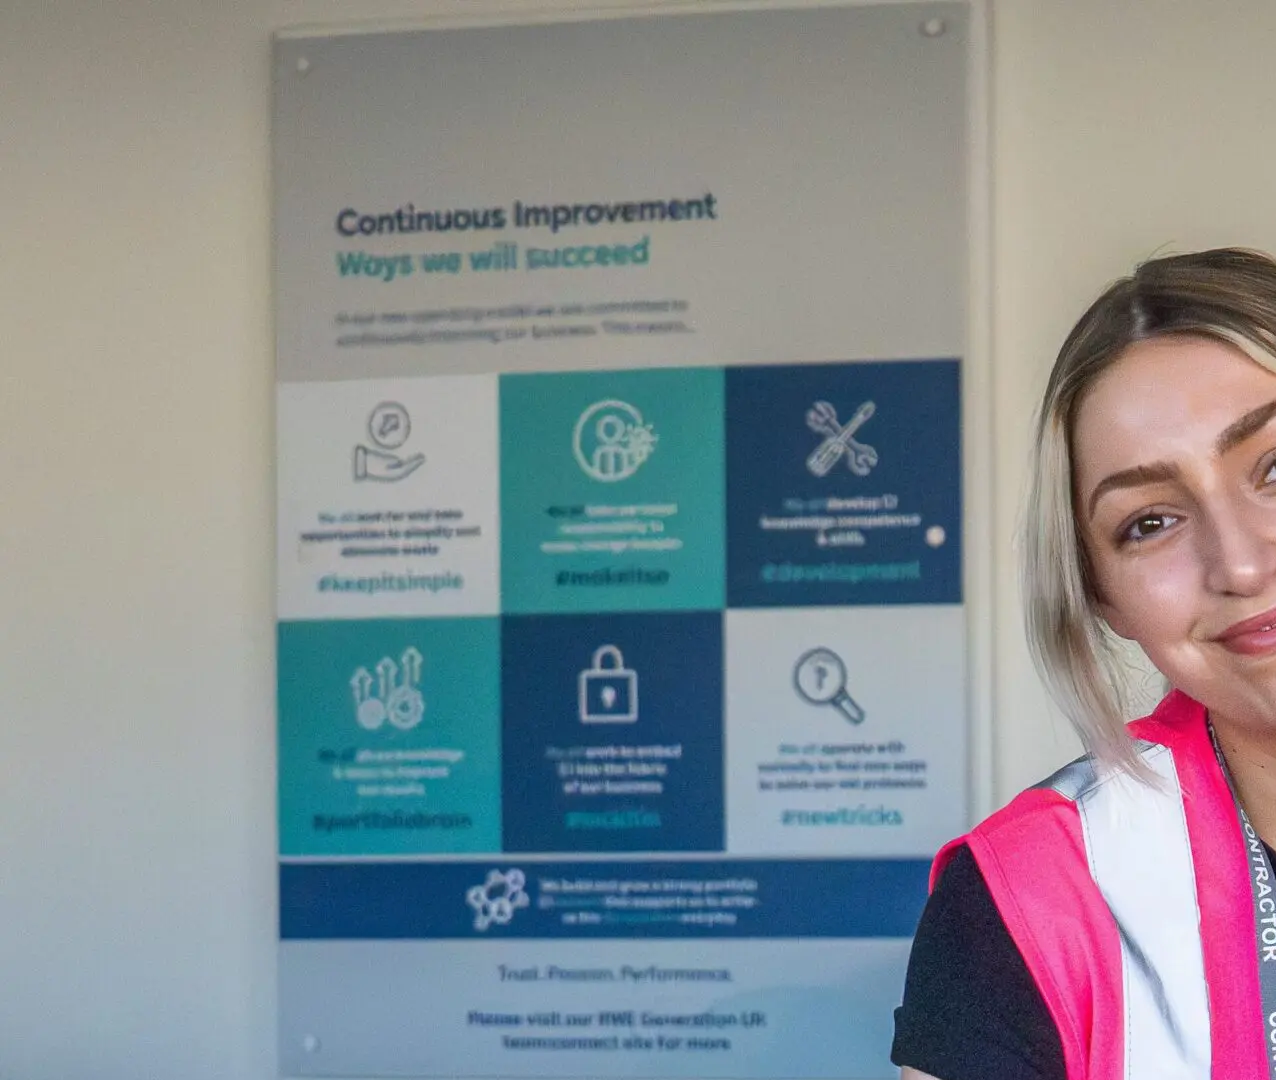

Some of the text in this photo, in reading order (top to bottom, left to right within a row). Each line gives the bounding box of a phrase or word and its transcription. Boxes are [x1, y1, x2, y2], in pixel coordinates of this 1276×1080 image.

[336, 193, 717, 237] Continuous Improvement
[336, 236, 651, 282] Ways we will succeed
